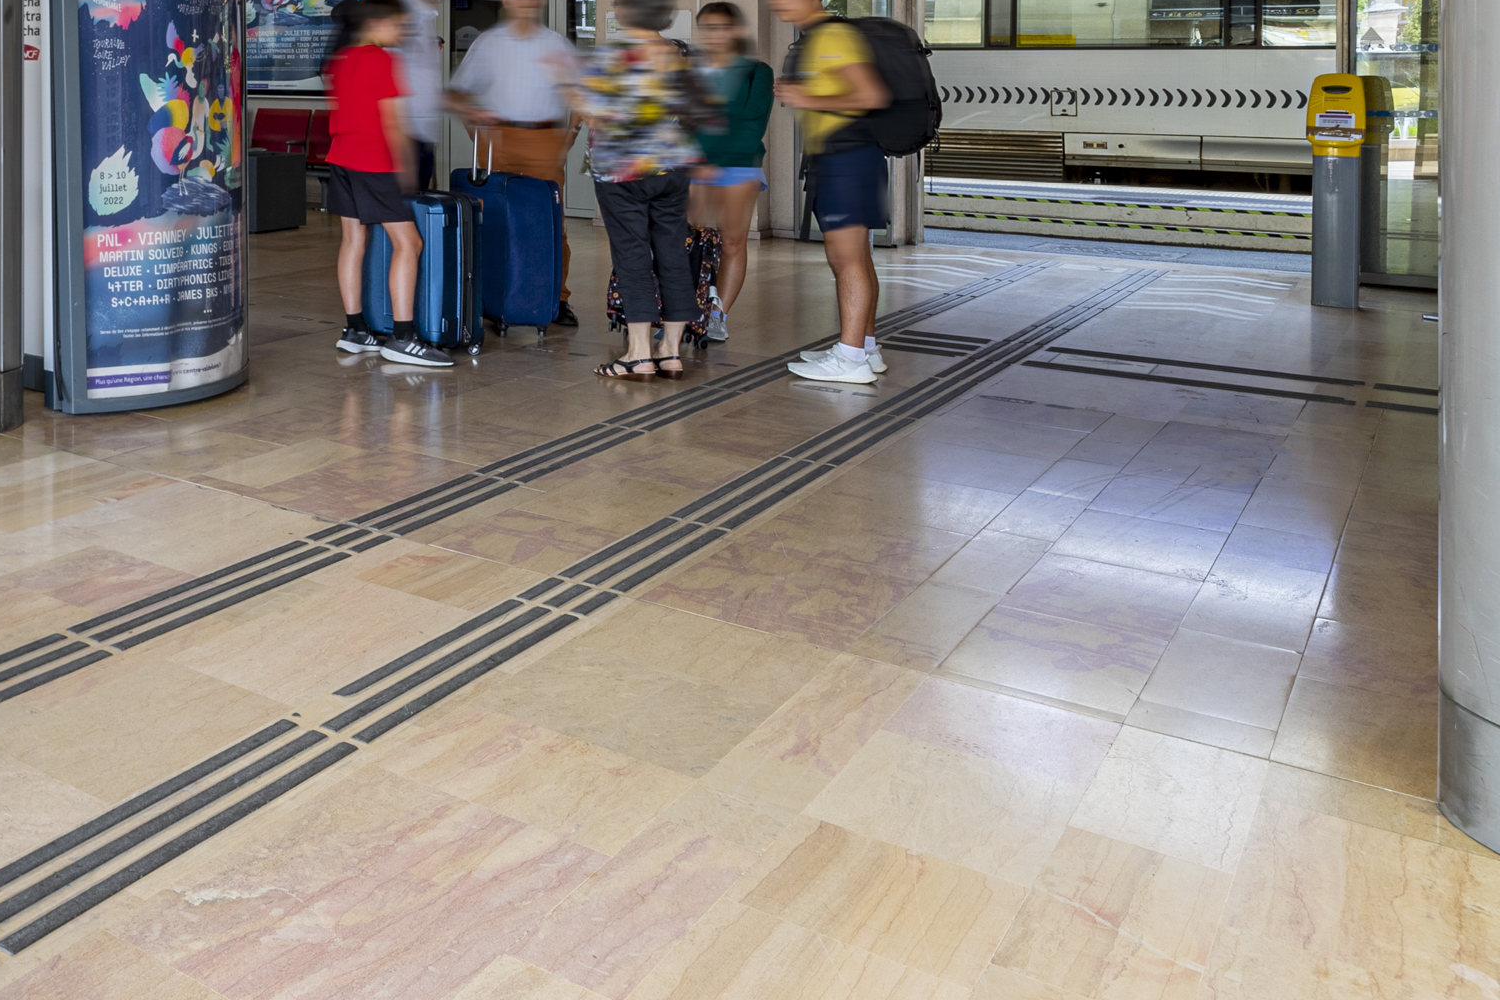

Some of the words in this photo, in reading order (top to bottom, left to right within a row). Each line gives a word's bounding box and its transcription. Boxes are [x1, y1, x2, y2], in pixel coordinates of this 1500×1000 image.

[24, 49, 38, 59] NCF
[102, 55, 130, 70] VALLEY
[99, 172, 105, 180] 8
[116, 171, 126, 179] 10
[99, 183, 127, 194] juillet
[104, 196, 124, 205] 2022
[97, 234, 122, 248] PNL
[138, 229, 187, 246] VIANNEY
[196, 222, 234, 240] JULIETTE
[99, 250, 144, 263] MARTIN
[148, 247, 184, 261] SOLVEIG
[191, 243, 218, 255] KUNGS
[104, 265, 142, 278] DELUXE
[154, 258, 213, 276] L'IMPÉRATRICE
[108, 281, 143, 292] 47TER
[156, 272, 217, 290] DIRTYPHONICS
[111, 294, 171, 308] S+C+A+R+R
[177, 289, 203, 302] JAMES
[205, 287, 218, 299] BKS
[95, 377, 105, 385] Plus
[106, 377, 122, 385] qu'une
[124, 375, 143, 384] Région,
[154, 373, 170, 381] chanc
